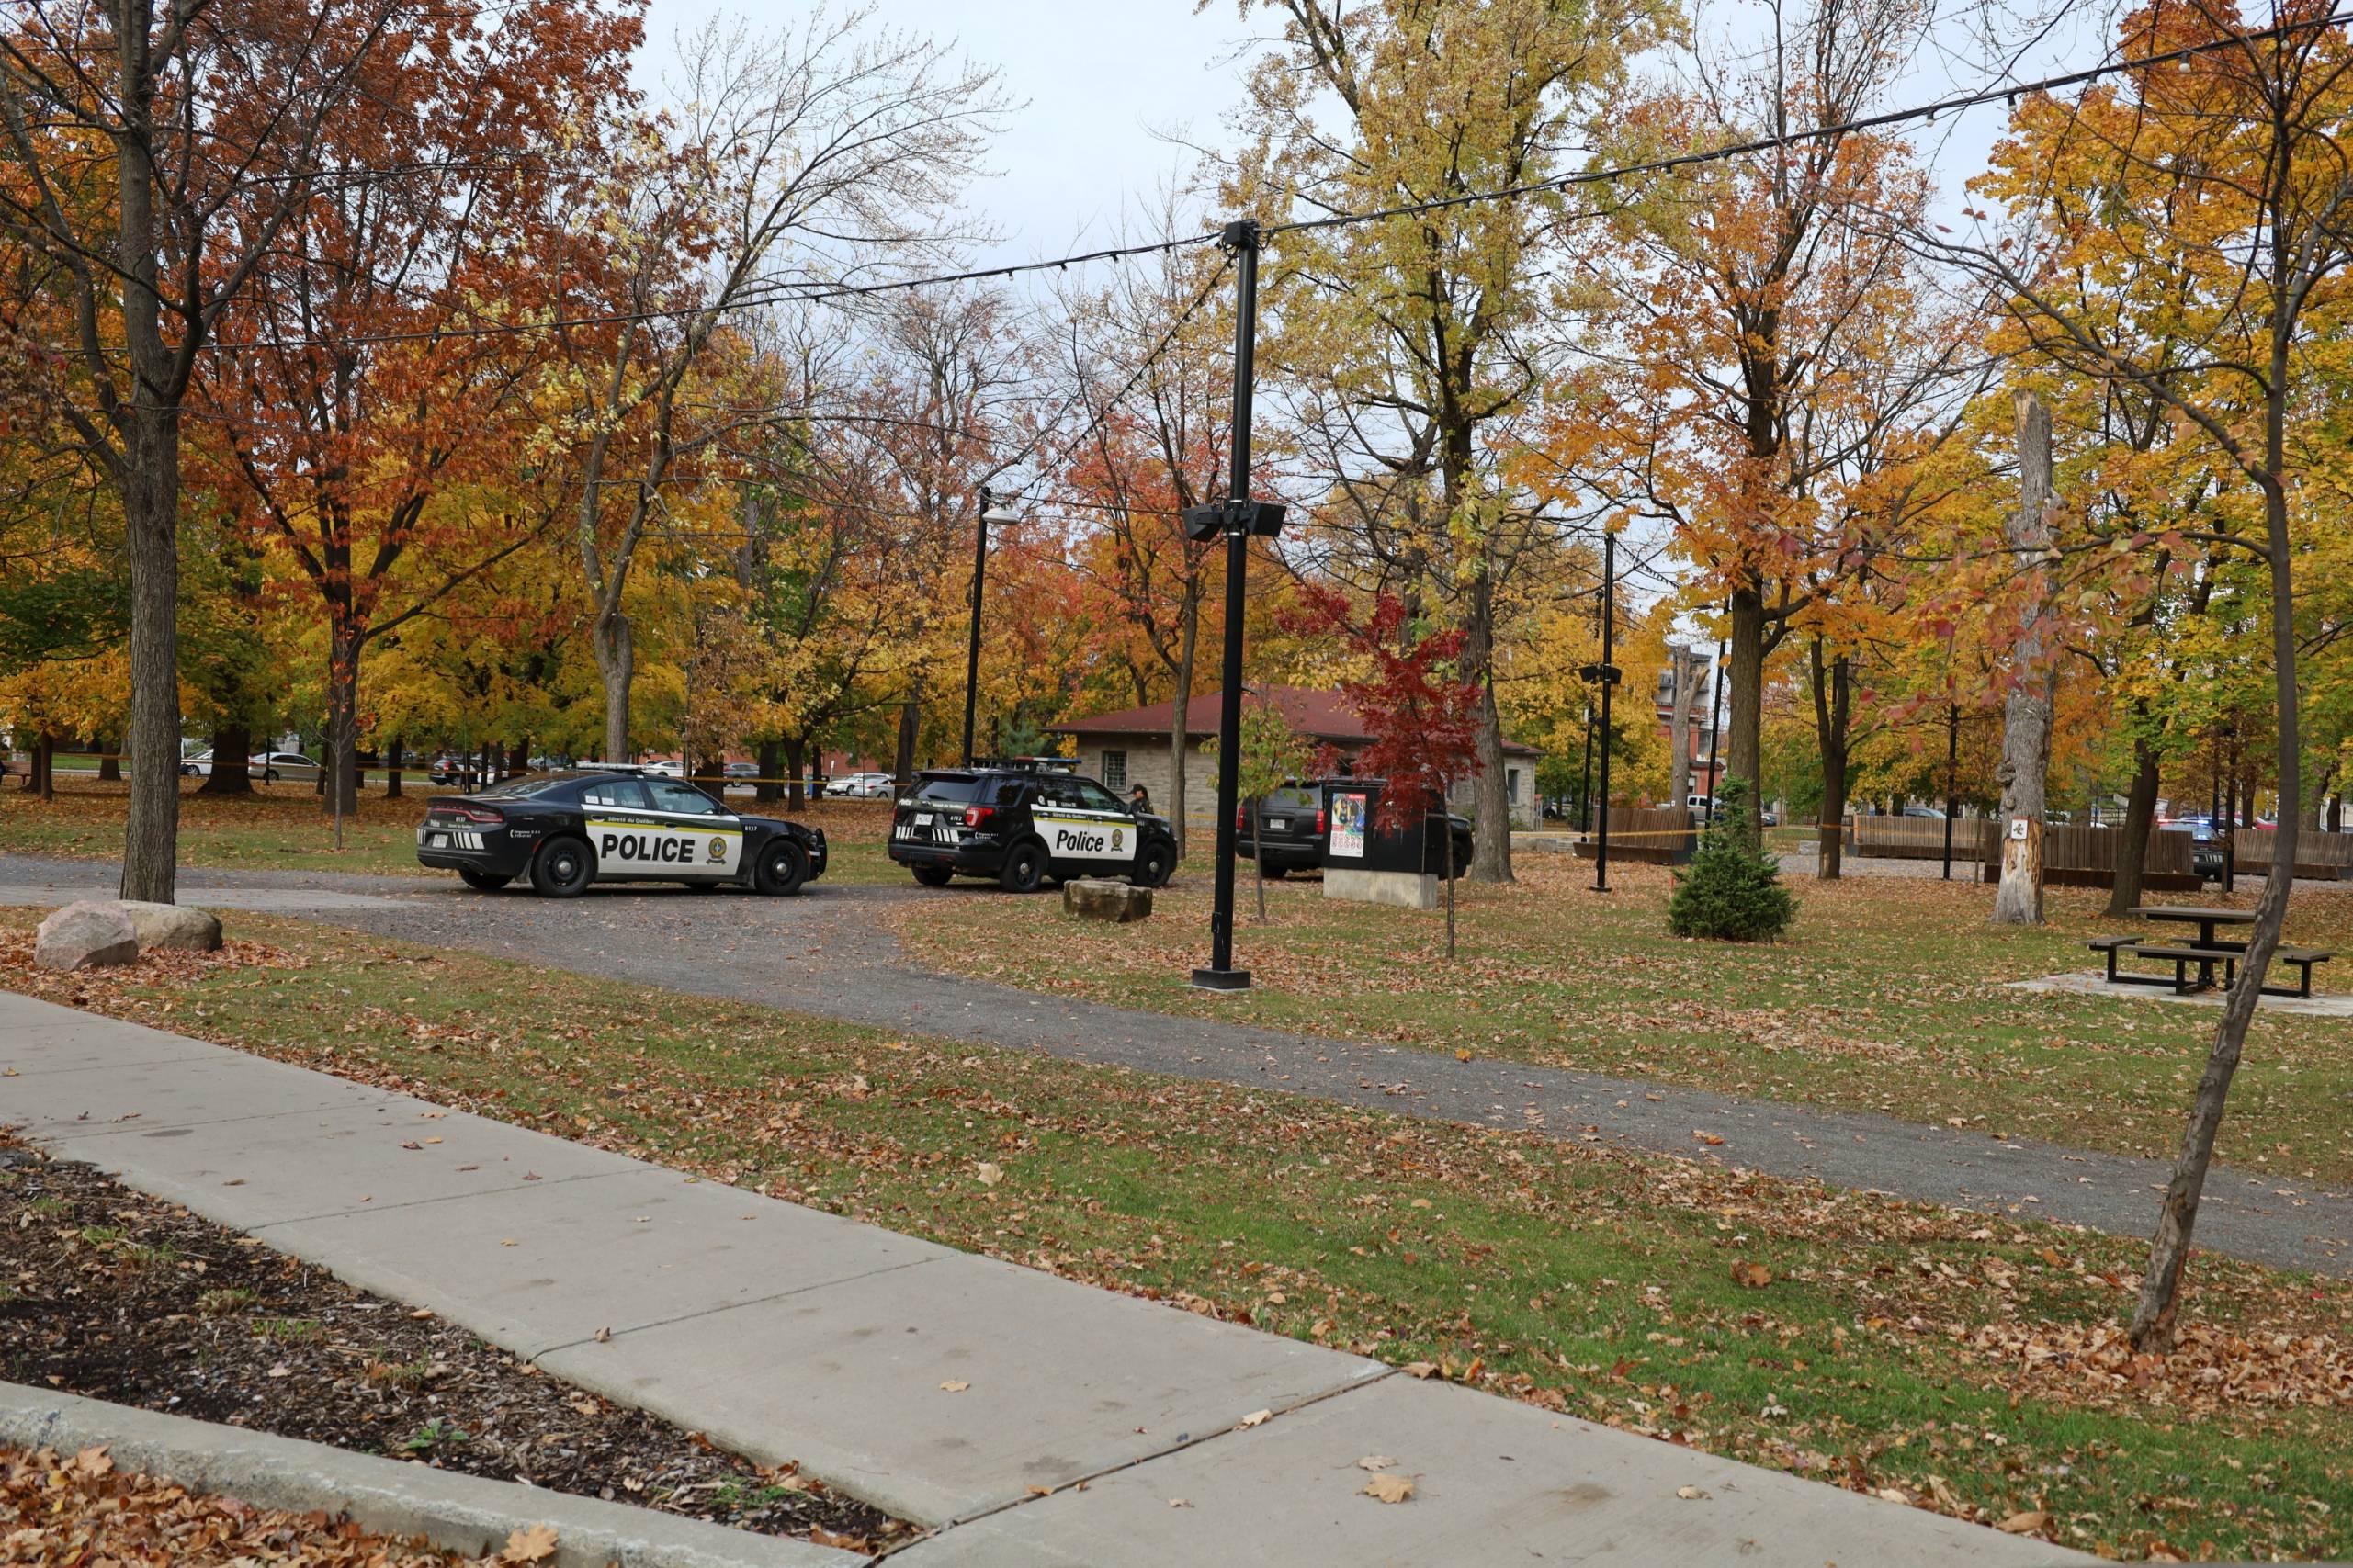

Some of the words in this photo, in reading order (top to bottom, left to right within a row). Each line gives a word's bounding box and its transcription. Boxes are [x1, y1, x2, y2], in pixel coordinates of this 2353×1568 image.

[608, 816, 627, 824] Sûreté
[601, 834, 696, 863] POLICE
[1057, 829, 1103, 852] Police
